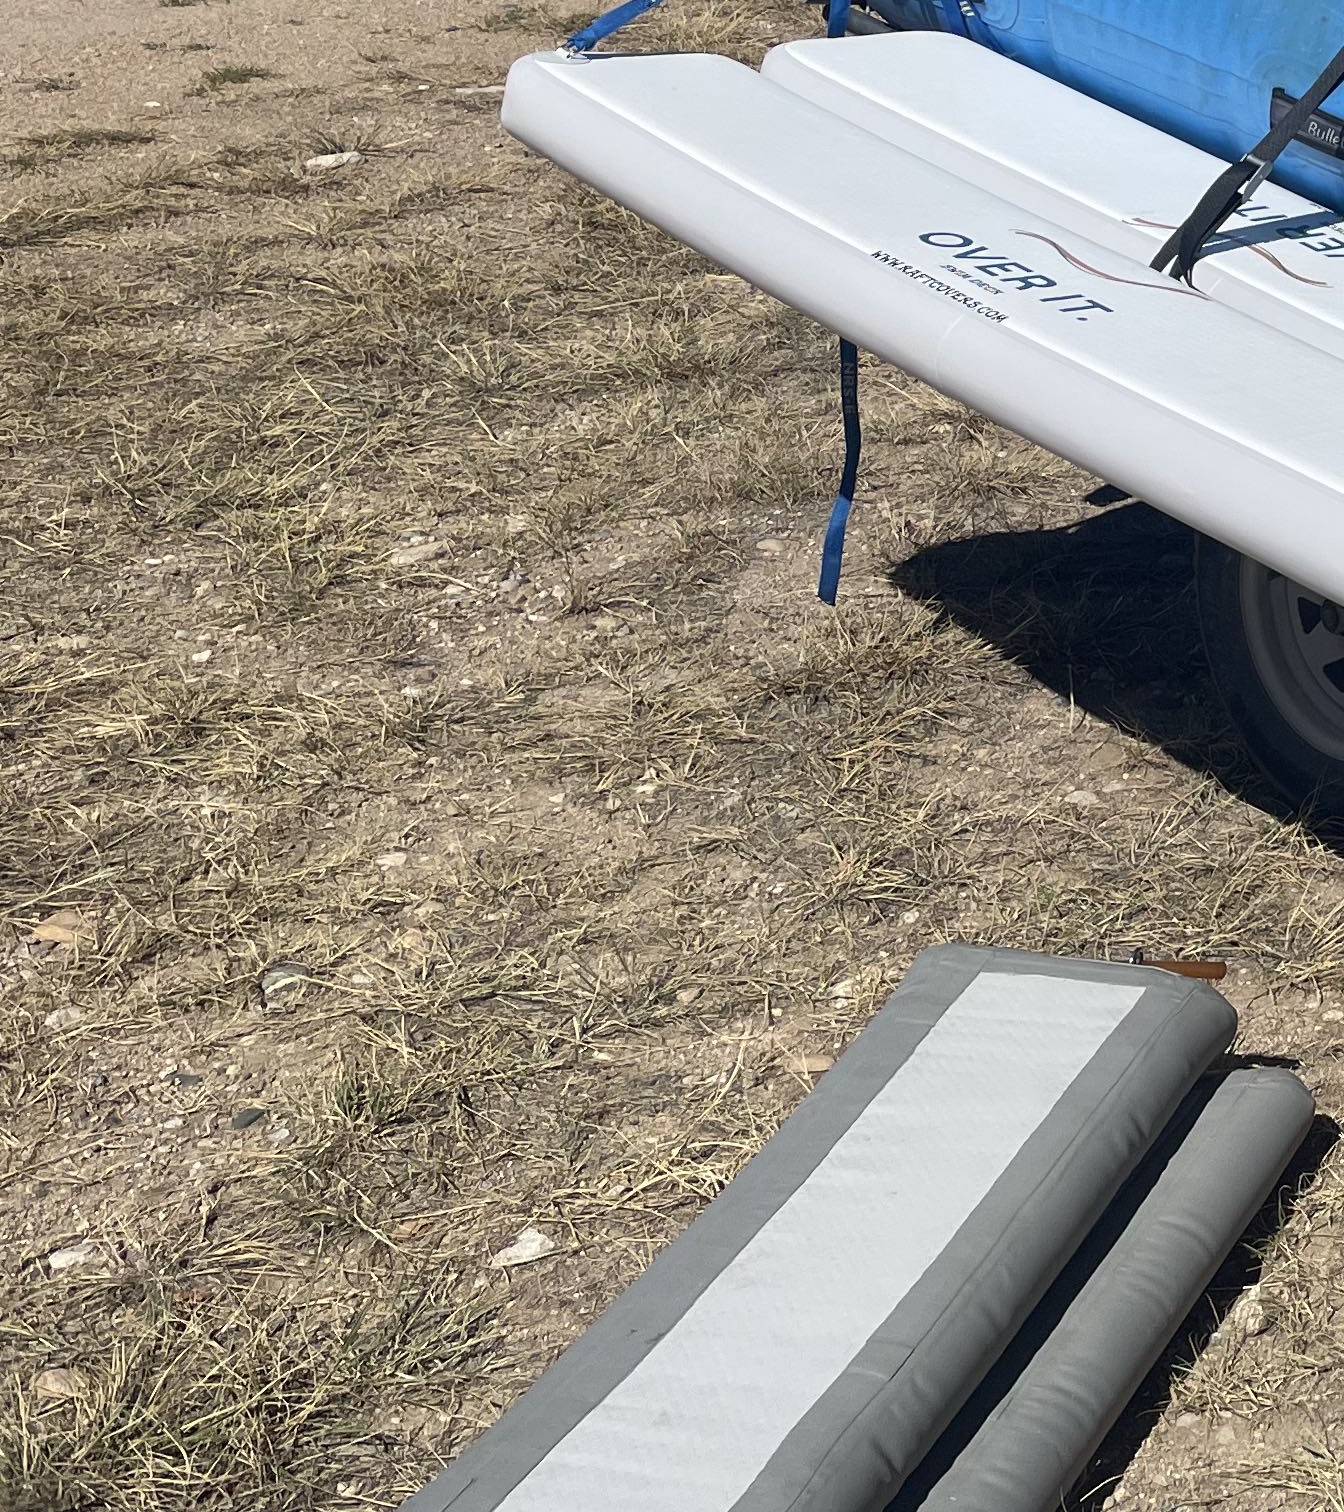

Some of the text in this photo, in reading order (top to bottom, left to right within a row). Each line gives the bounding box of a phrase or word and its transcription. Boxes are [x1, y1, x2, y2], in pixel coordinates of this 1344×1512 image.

[1307, 121, 1344, 150] Bullet
[871, 250, 1009, 323] WWW.RAFTCOVERS.COM
[918, 232, 1114, 321] OVER IT.
